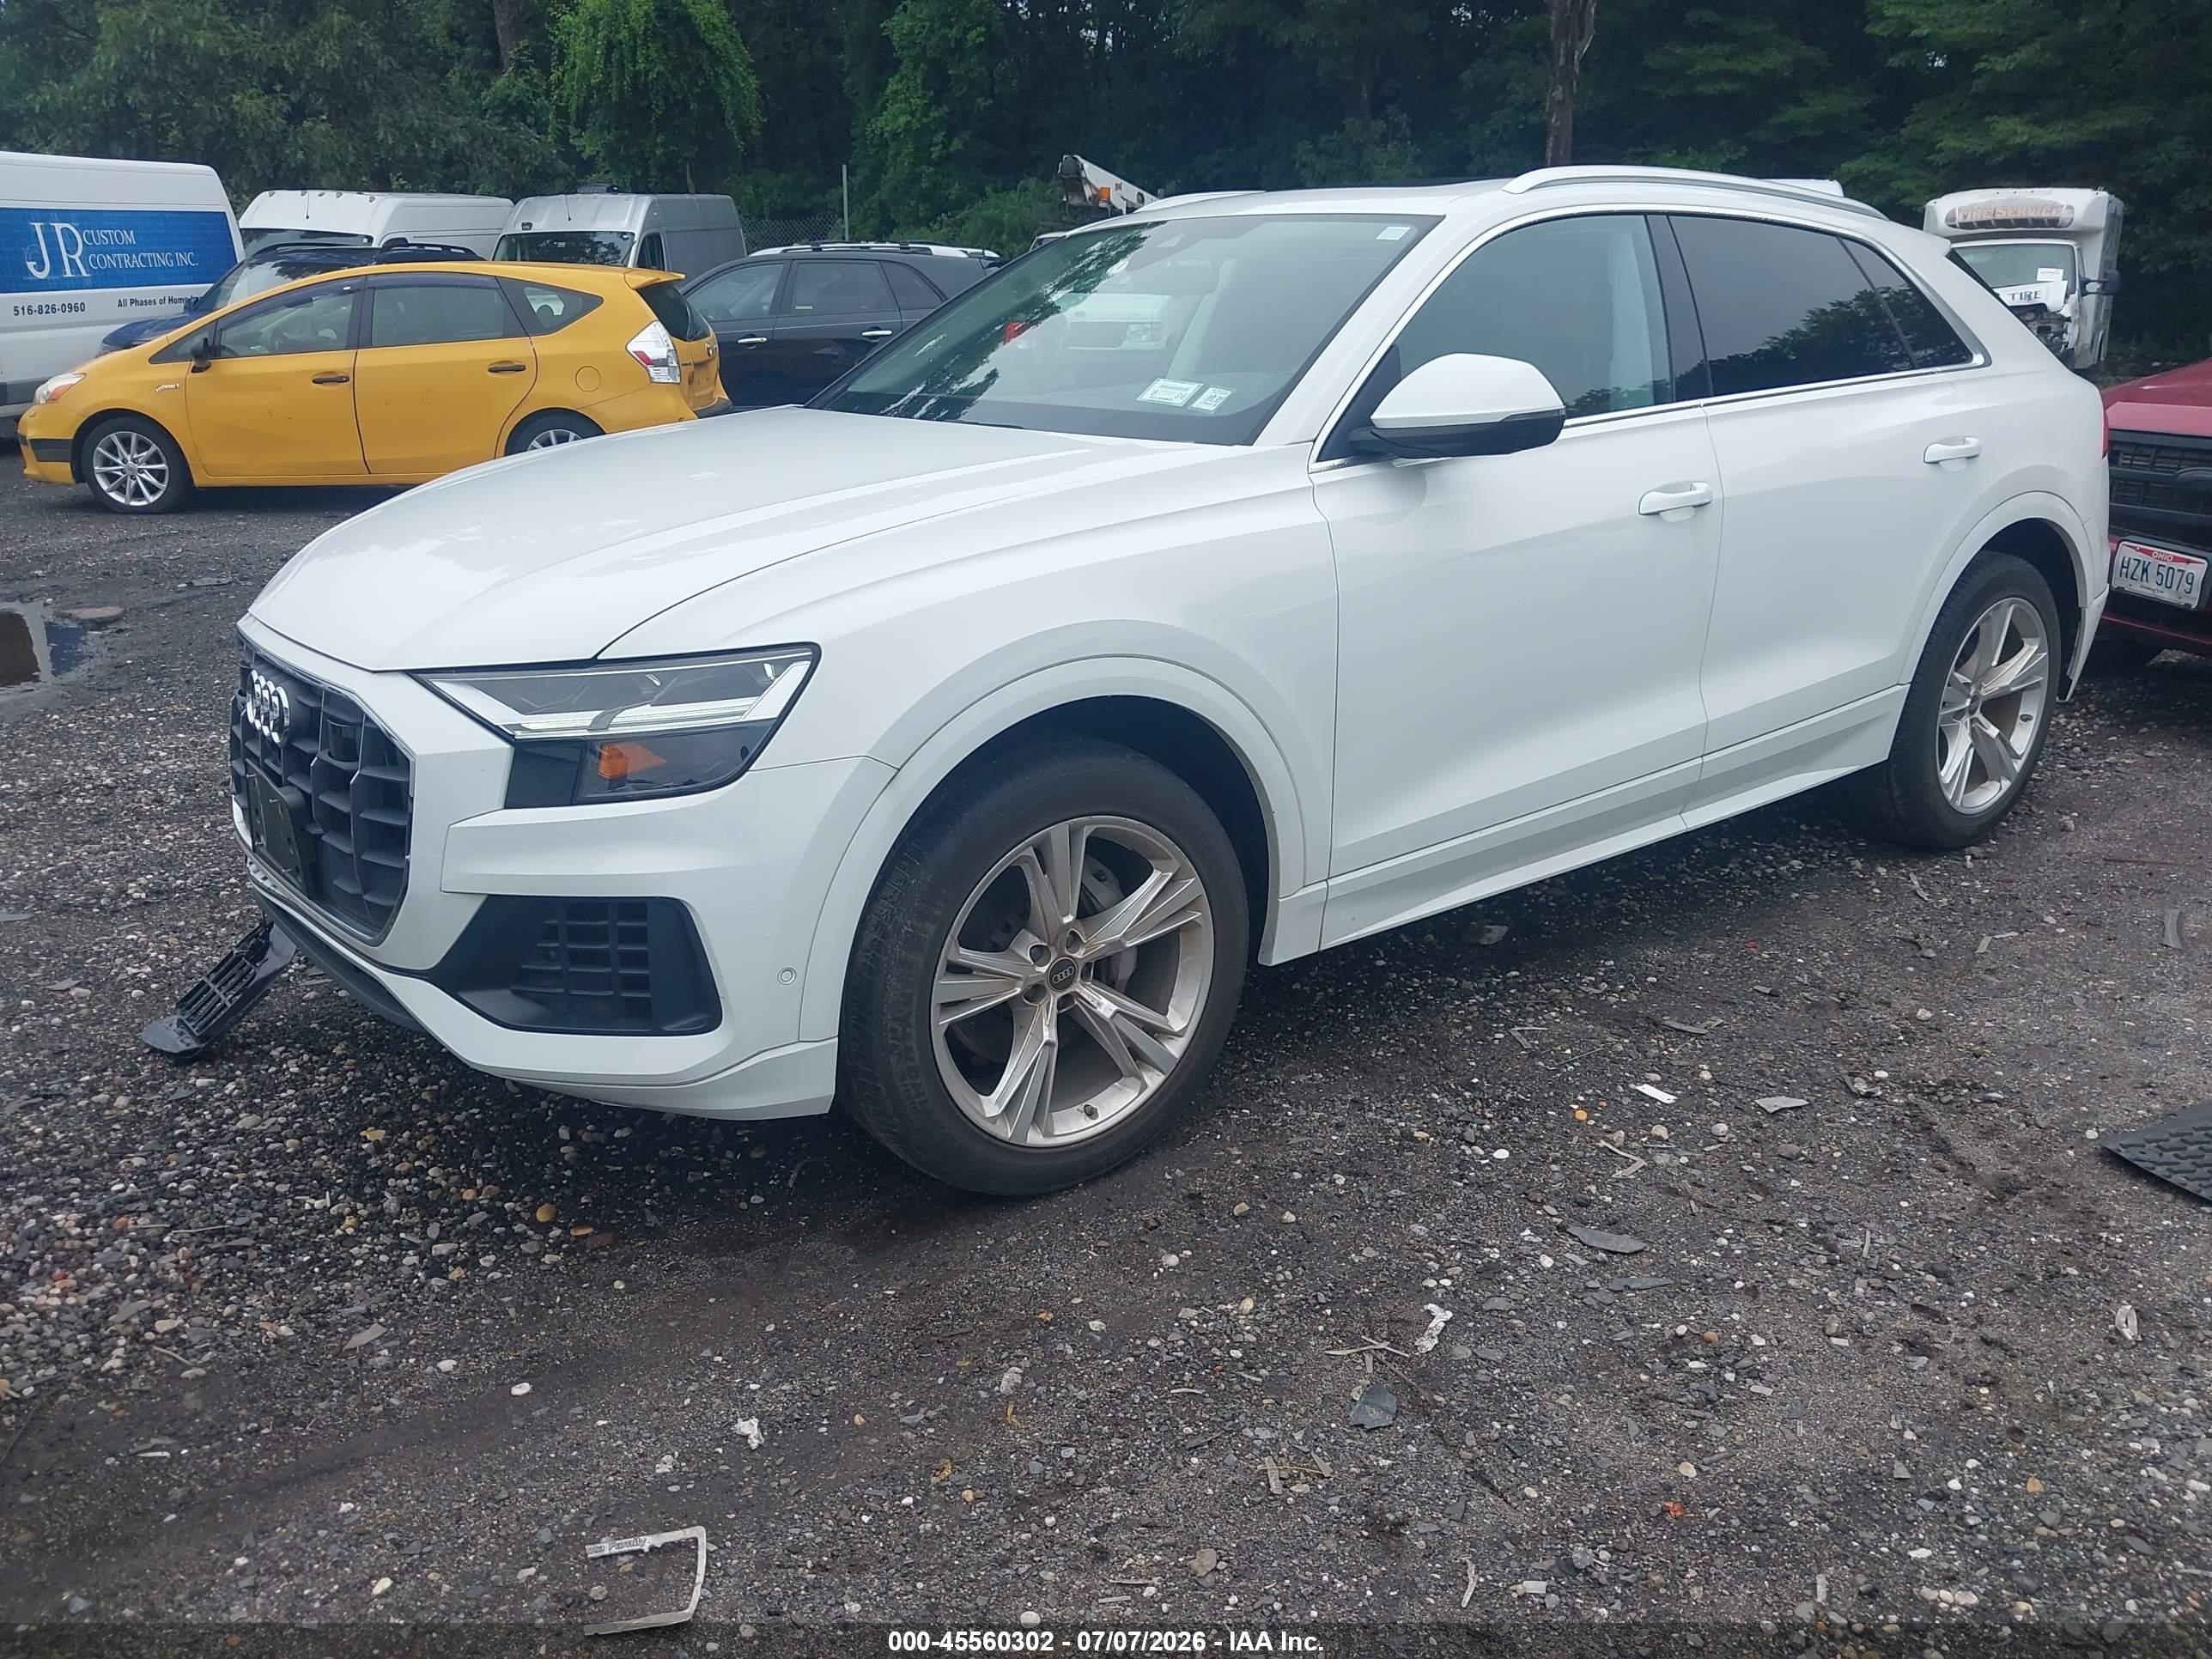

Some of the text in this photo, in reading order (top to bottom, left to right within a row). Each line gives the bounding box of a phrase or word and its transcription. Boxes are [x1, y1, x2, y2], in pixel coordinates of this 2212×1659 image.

[82, 229, 137, 246] CUSTOM
[27, 222, 90, 279] JR
[88, 252, 199, 270] CONTRACTING INC.
[118, 299, 128, 308] All
[130, 297, 157, 307] Phases
[159, 296, 167, 306] of
[2008, 290, 2042, 302] TIRE
[13, 301, 86, 316] 516-826-0960
[2151, 550, 2174, 562] OHIO
[2119, 556, 2195, 594] HZK 5079
